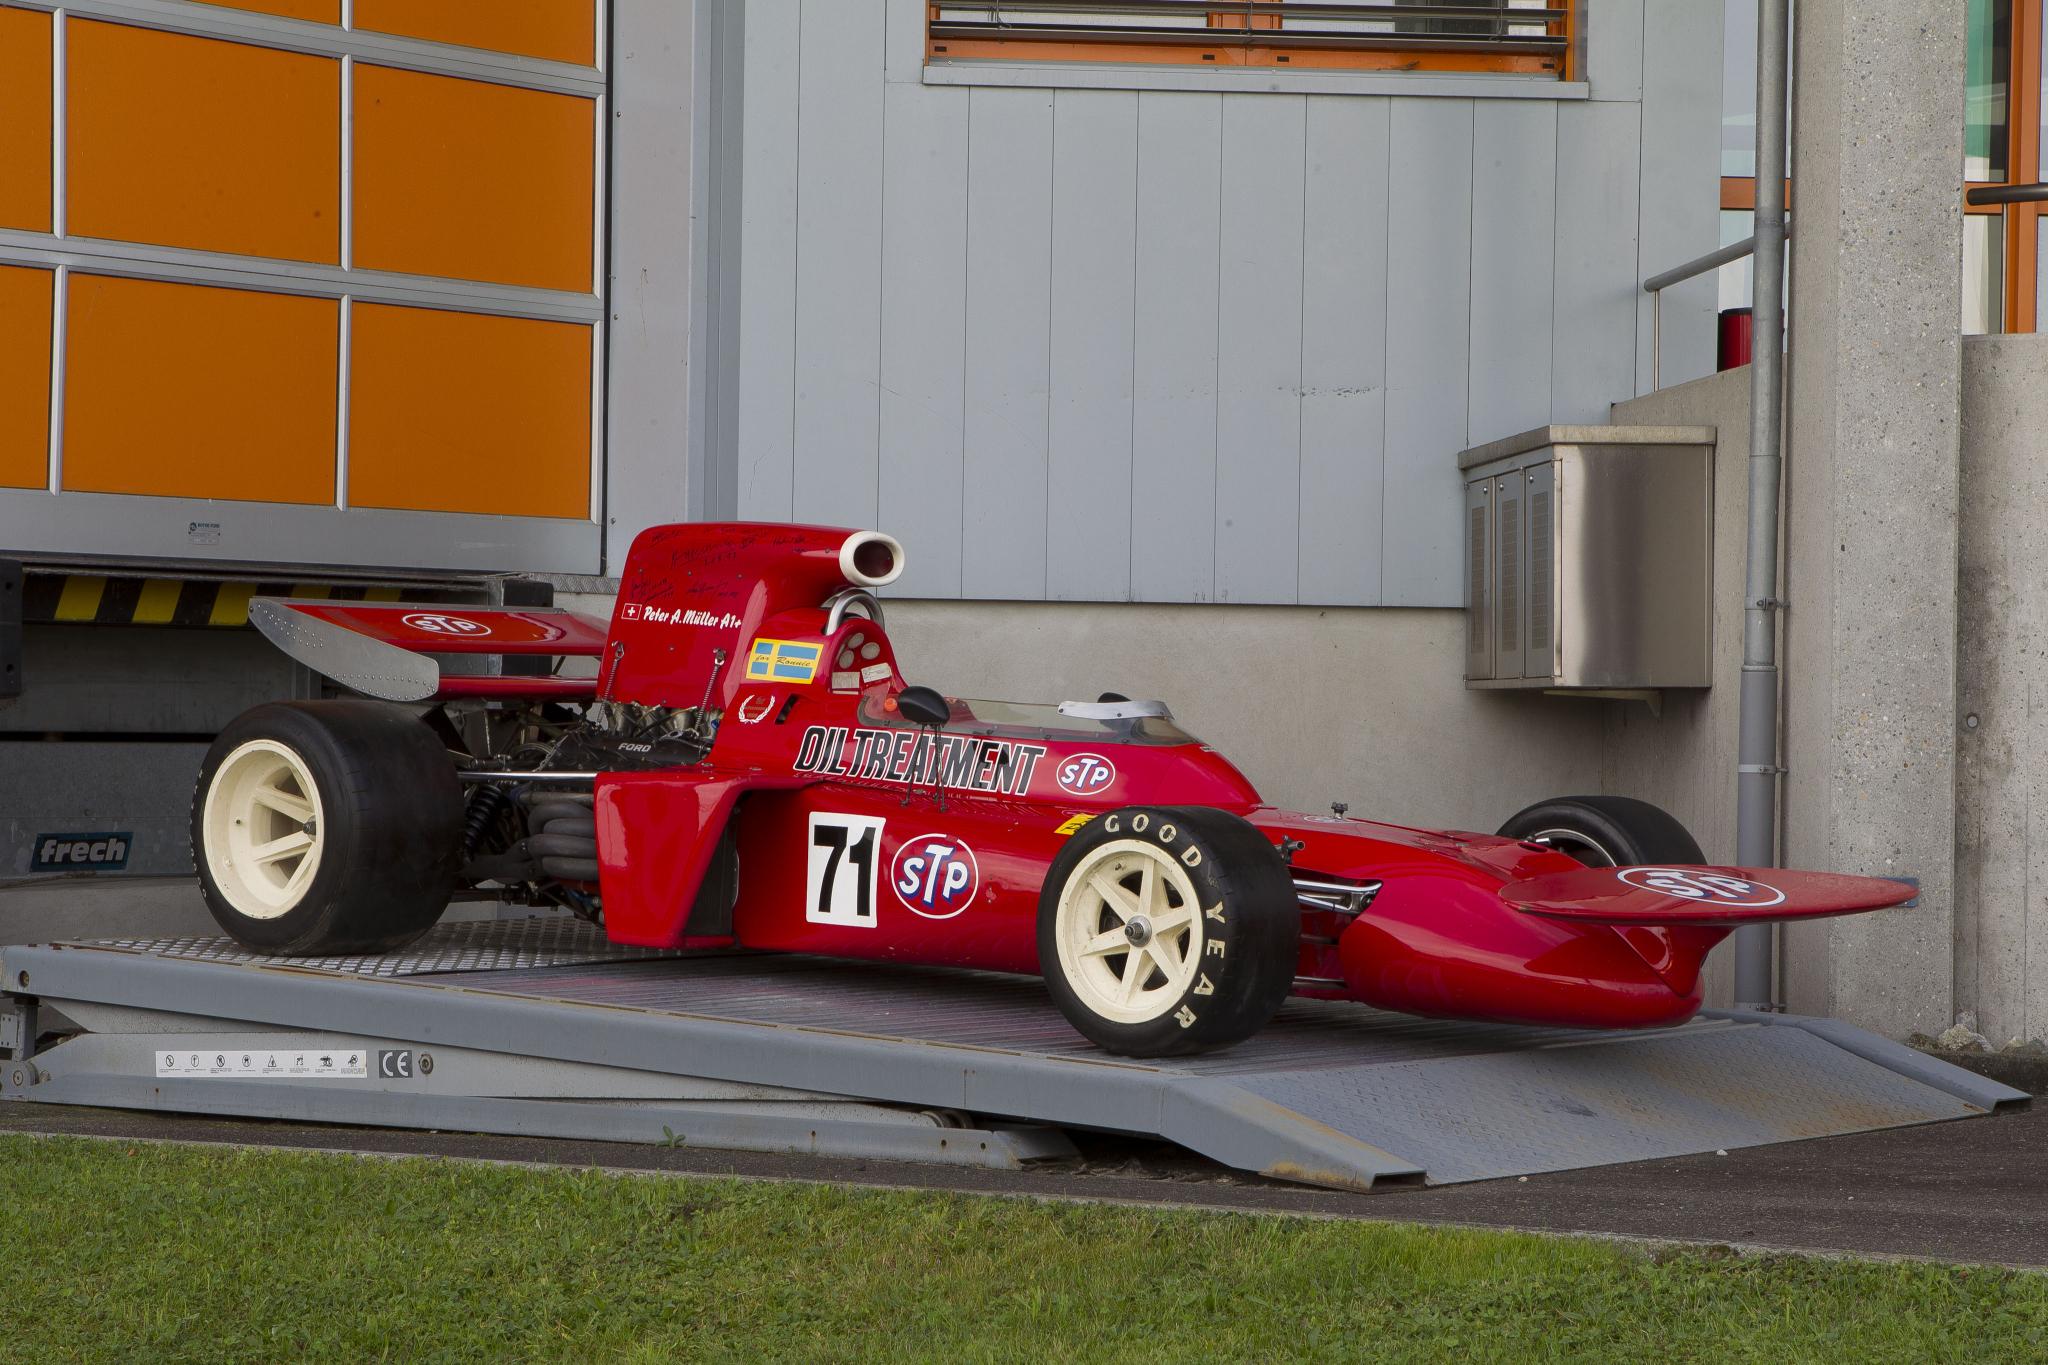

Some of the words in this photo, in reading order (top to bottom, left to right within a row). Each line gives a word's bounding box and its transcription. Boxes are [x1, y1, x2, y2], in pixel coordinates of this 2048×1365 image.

[415, 616, 477, 633] STP
[643, 605, 670, 622] Peter
[755, 654, 770, 662] for
[775, 656, 812, 667] Ronnie
[618, 742, 652, 752] FORD
[793, 725, 849, 778] OIL
[847, 730, 1047, 796] TREATMENT
[1061, 757, 1109, 788] STP
[40, 837, 127, 863] frech
[814, 824, 876, 916] 71
[899, 843, 969, 908] STP
[1645, 872, 1752, 898] STP
[382, 1051, 410, 1077] CE
